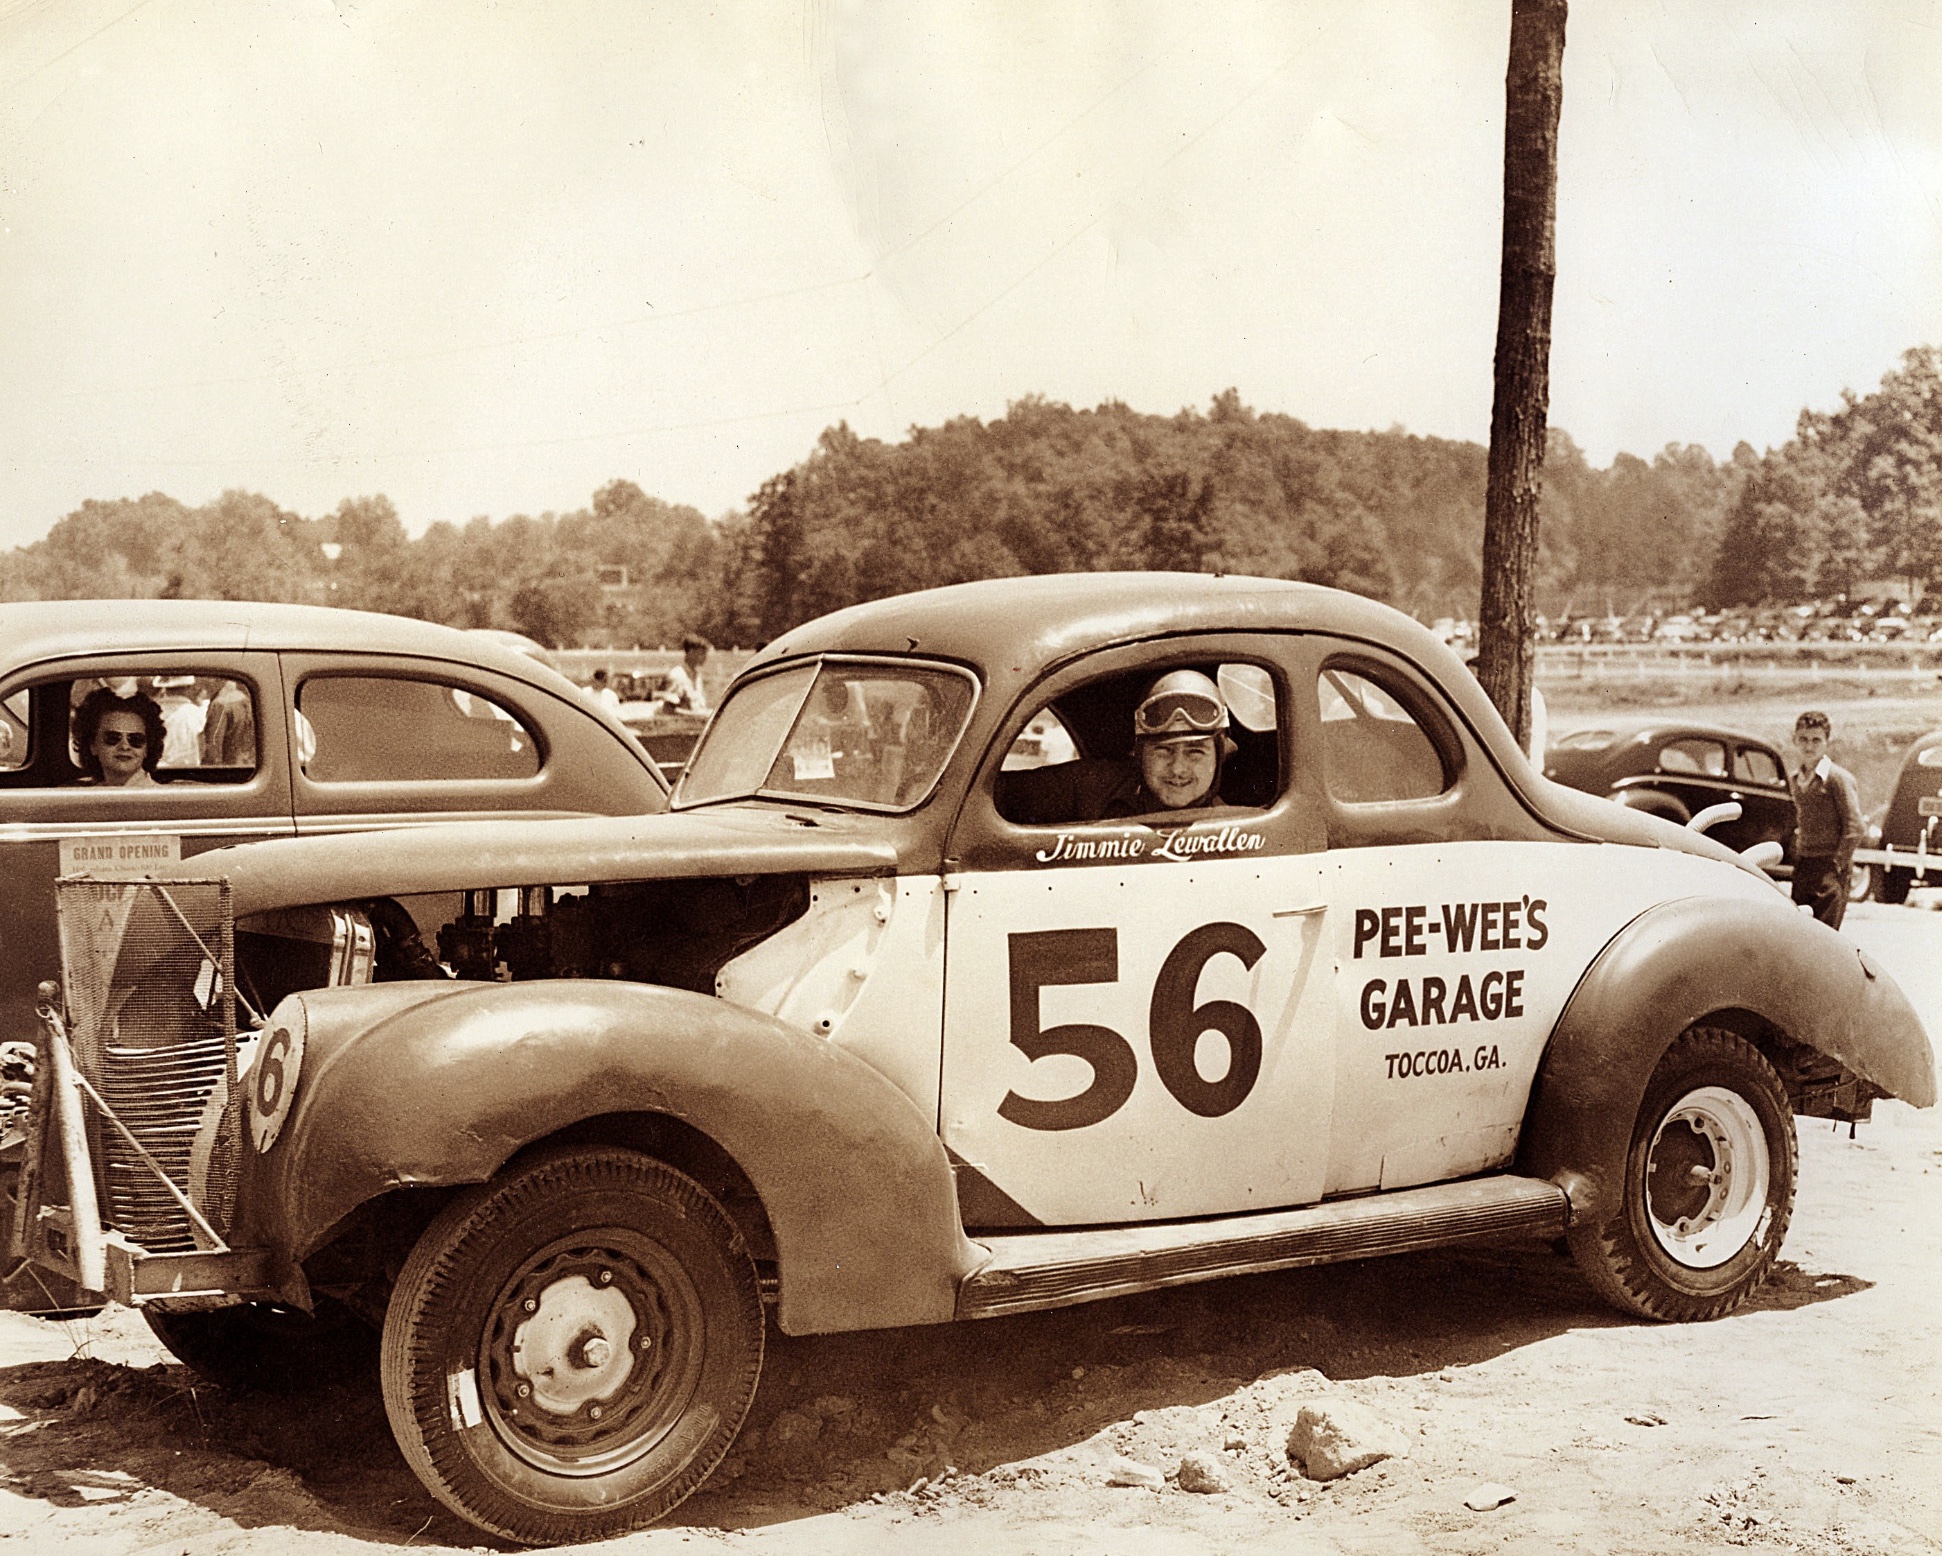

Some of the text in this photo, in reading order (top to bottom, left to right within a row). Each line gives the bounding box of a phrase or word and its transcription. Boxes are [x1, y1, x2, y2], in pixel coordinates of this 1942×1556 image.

[73, 844, 169, 861] GRAND OPENING
[1036, 826, 1267, 862] Jimmie Lewallen
[1353, 894, 1549, 959] PEE-WEE'S
[996, 921, 1268, 1132] 56
[1360, 969, 1525, 1030] GARAGE
[256, 1027, 291, 1118] 6
[1474, 1044, 1507, 1070] GA.
